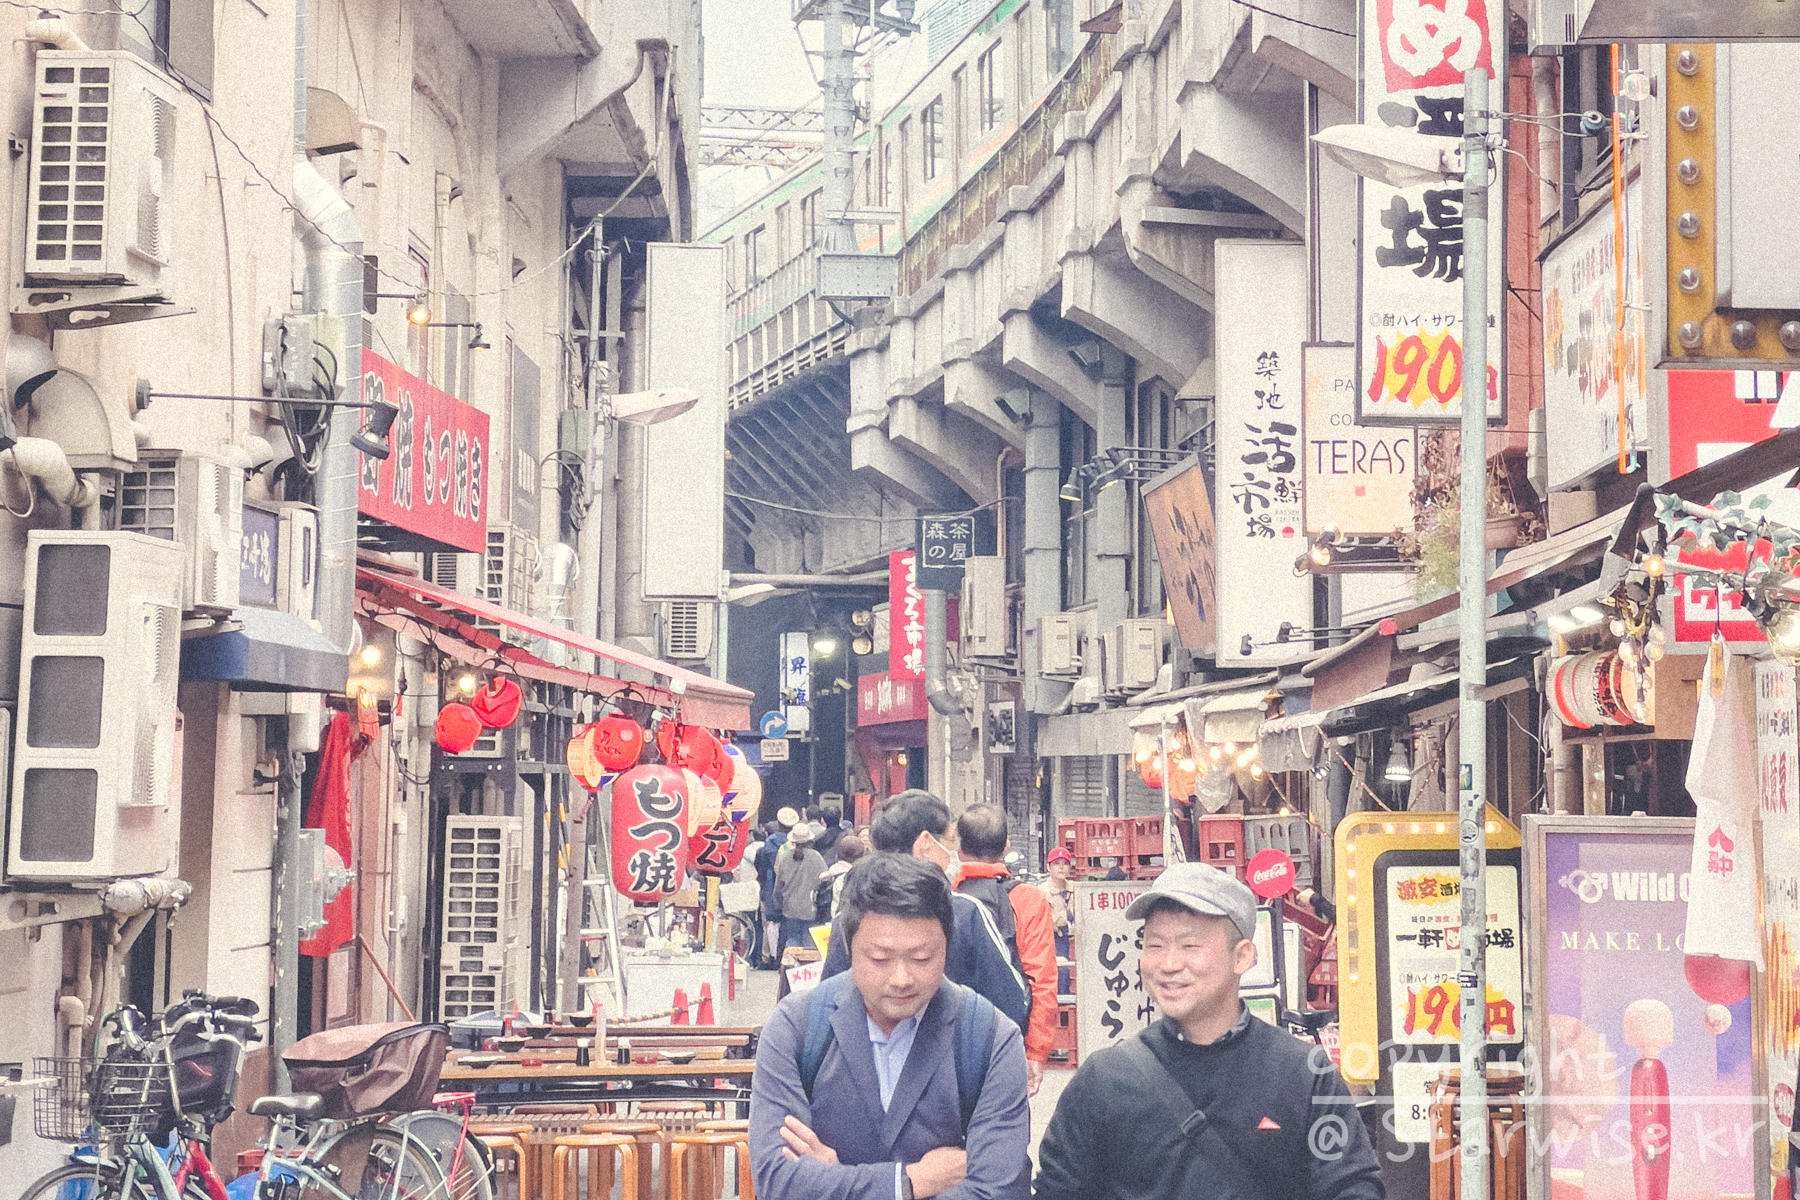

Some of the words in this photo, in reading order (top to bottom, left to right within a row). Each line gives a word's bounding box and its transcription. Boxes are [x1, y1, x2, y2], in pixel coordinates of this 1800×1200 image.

[1254, 350, 1285, 411] 築地
[1334, 378, 1355, 392] PA
[1330, 413, 1352, 426] CO
[422, 414, 482, 523] もつ焼き
[1311, 438, 1410, 475] TERAS
[628, 776, 684, 894] もつ焼
[1611, 871, 1675, 902] Wild
[1561, 931, 1641, 951] MAKE
